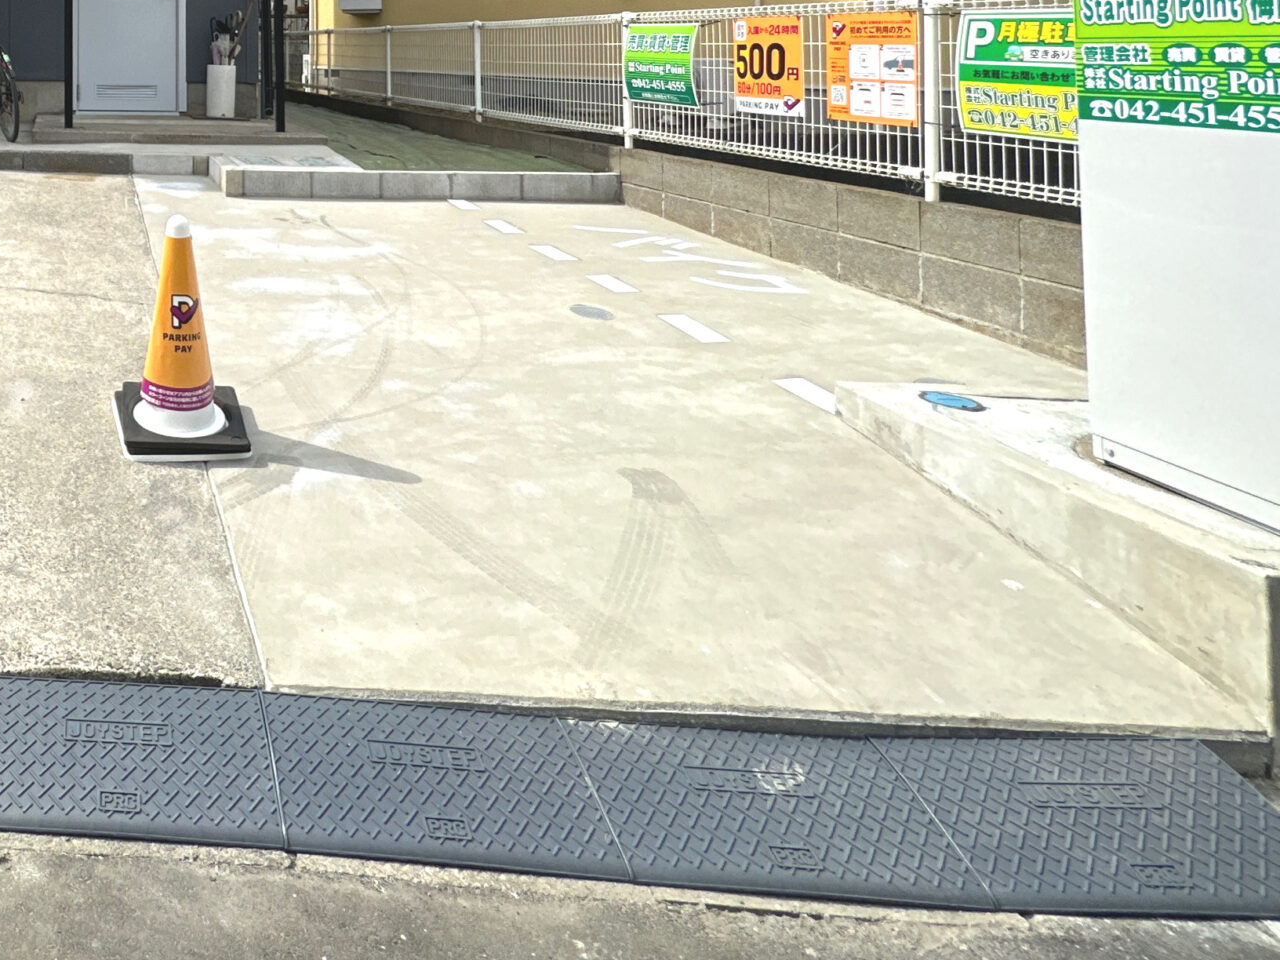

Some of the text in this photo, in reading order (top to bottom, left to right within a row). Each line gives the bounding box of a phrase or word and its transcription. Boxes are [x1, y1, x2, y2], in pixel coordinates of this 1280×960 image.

[966, 20, 995, 59] P
[736, 43, 799, 81] 500円
[1030, 49, 1076, 60] 空きあり
[1084, 46, 1148, 63] 管理会社
[635, 62, 664, 75] Starting
[665, 63, 685, 74] Point
[973, 69, 1076, 82] お気軽にお問い合わせ
[638, 79, 686, 92] 042-451-4555
[1109, 68, 1219, 99] Starting
[1228, 70, 1280, 96] Poi
[764, 103, 779, 111] PAY
[982, 88, 1058, 112] Starting
[174, 345, 192, 353] PAY
[70, 722, 168, 743] JOYSTEP
[375, 743, 477, 767] JOYSTEP
